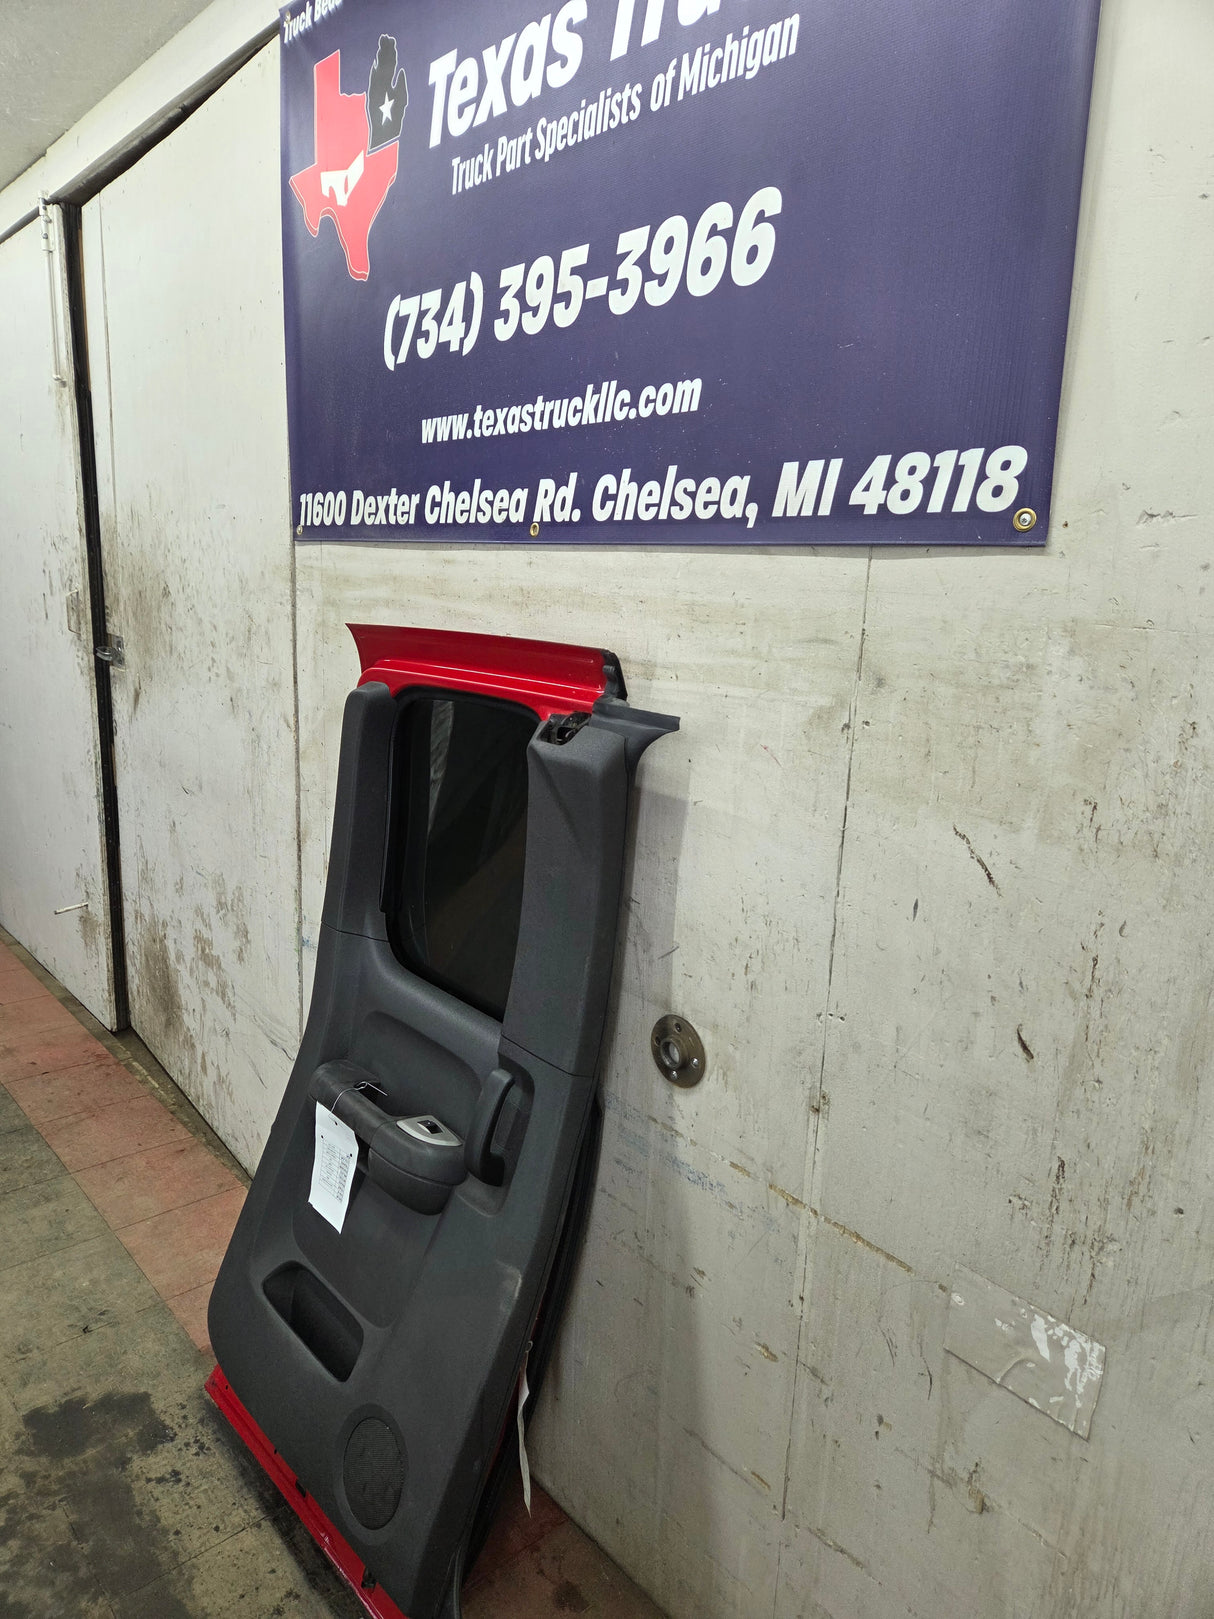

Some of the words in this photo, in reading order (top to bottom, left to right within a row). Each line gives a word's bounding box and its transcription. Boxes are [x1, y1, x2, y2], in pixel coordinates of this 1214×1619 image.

[283, 1, 313, 44] Truck
[428, 0, 590, 149] Texas
[609, 0, 722, 62] Tr
[451, 142, 495, 195] Truck
[496, 126, 534, 177] Part
[534, 82, 643, 163] Specialists
[649, 58, 678, 112] of
[676, 13, 801, 102] Michigan
[383, 271, 484, 372] (734)
[493, 186, 783, 342] 395-3966
[421, 377, 703, 444] www.texastruckllc.com
[298, 490, 347, 527] 11600
[350, 487, 421, 526] Dexter
[424, 478, 529, 525] Chelsea
[532, 471, 583, 524] Rd.
[592, 464, 759, 530] Chelsea,
[771, 457, 844, 517] MI
[848, 445, 1028, 516] 48118
